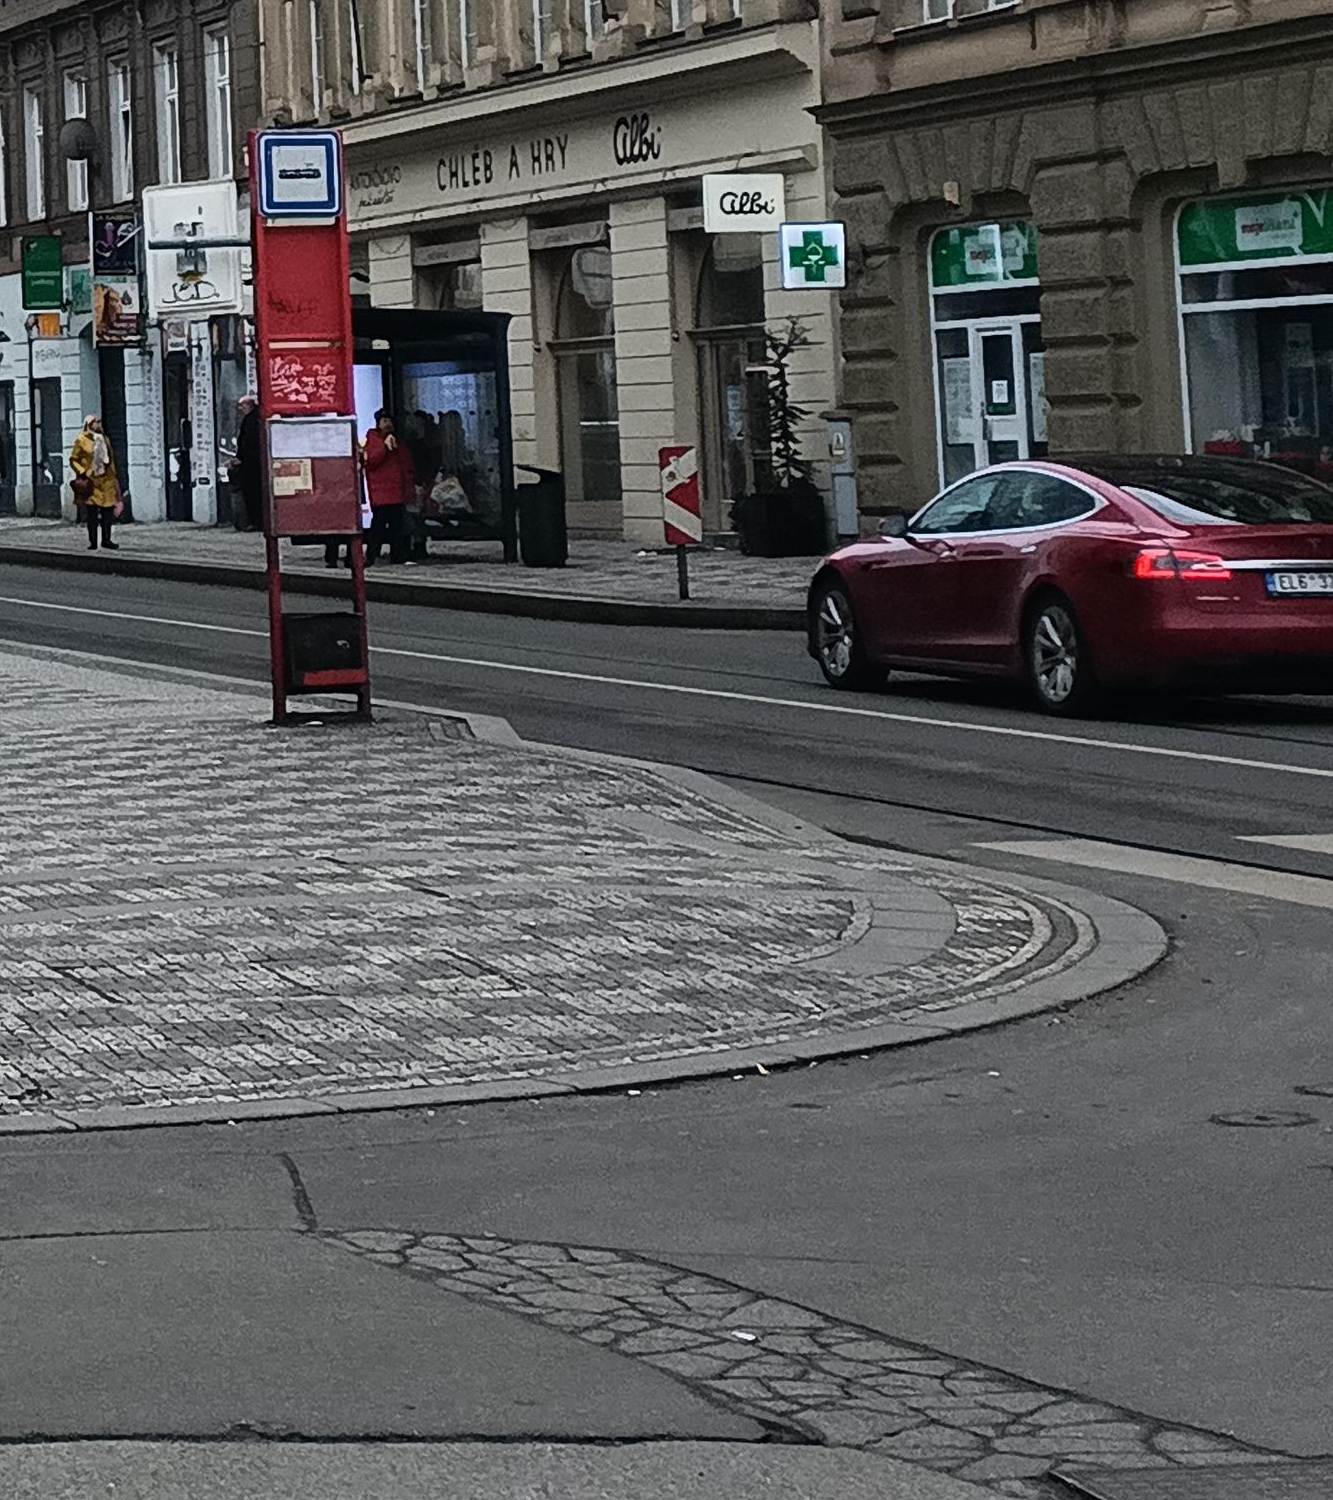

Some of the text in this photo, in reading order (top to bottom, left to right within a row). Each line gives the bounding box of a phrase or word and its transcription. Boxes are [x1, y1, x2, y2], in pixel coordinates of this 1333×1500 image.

[437, 143, 493, 191] CHLÉB
[509, 144, 520, 180] A
[530, 134, 568, 175] HRY
